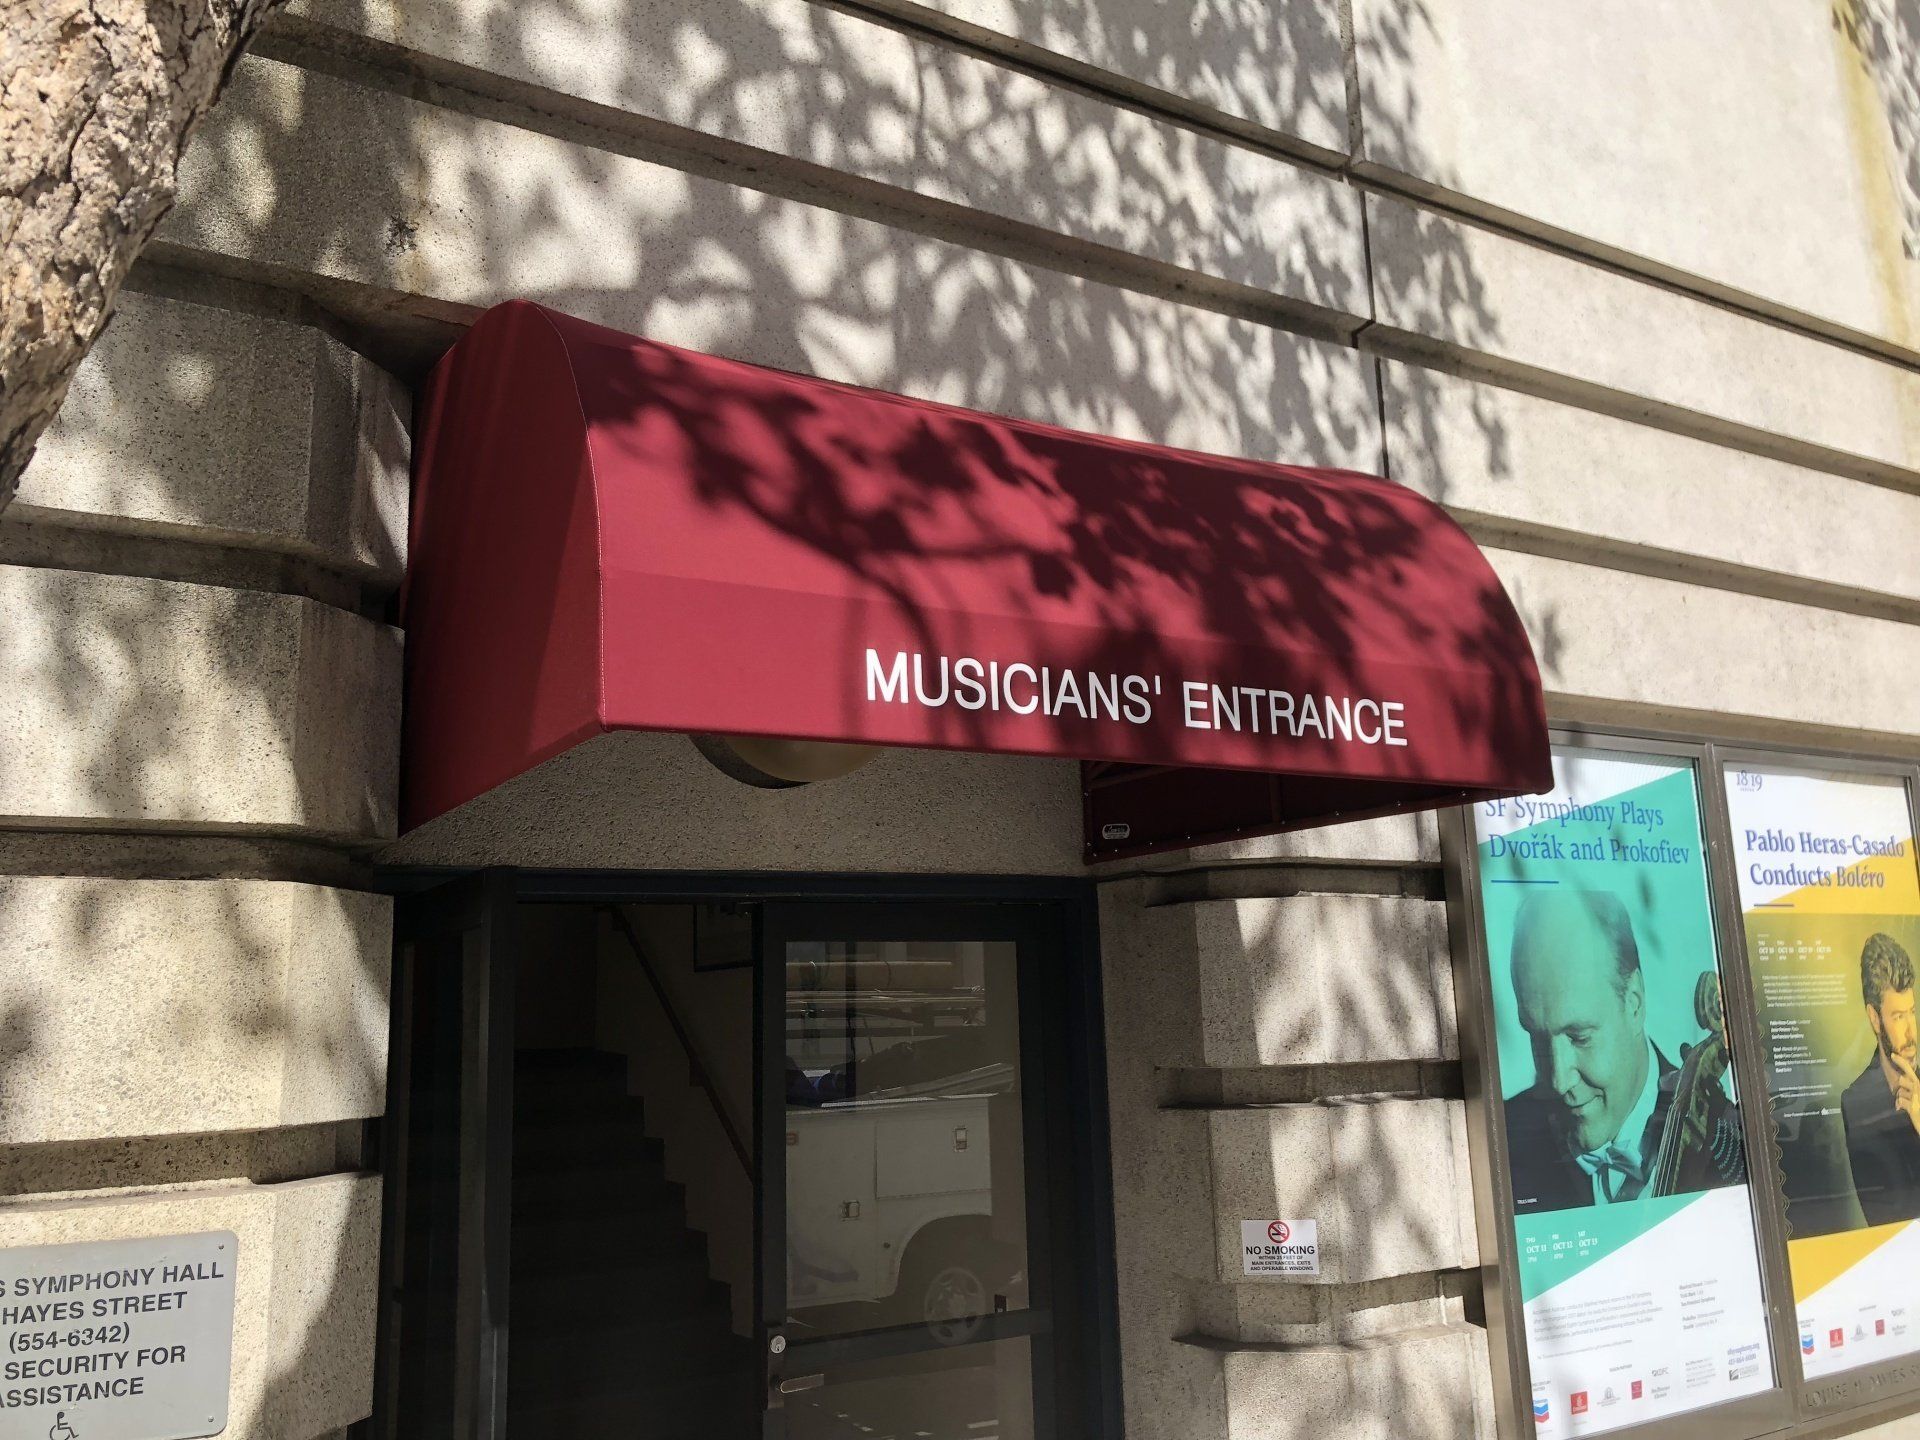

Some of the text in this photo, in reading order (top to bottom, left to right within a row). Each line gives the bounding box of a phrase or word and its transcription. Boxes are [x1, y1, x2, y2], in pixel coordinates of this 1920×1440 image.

[865, 648, 1408, 746] MUSICIANS' ENTRANCE
[1485, 795, 1664, 832] SF Symphony Plays
[1488, 832, 1690, 864] Dvořák and Prokofiev
[1745, 829, 1905, 858] Pablo Heras-Casado
[1750, 862, 1884, 888] Conducts Boléro
[1245, 1245, 1315, 1255] NO SMOKING
[1526, 1245, 1539, 1253] OCT
[1553, 1241, 1565, 1251] OCT
[1579, 1239, 1591, 1247] OCT
[14, 1267, 155, 1297] SYMPHONY
[162, 1261, 224, 1284] HALL
[2, 1291, 188, 1325] HAYES STREET
[9, 1322, 130, 1354] (554-6342)
[4, 1345, 186, 1381] SECURITY FOR
[0, 1376, 145, 1409] SSISTANCE
